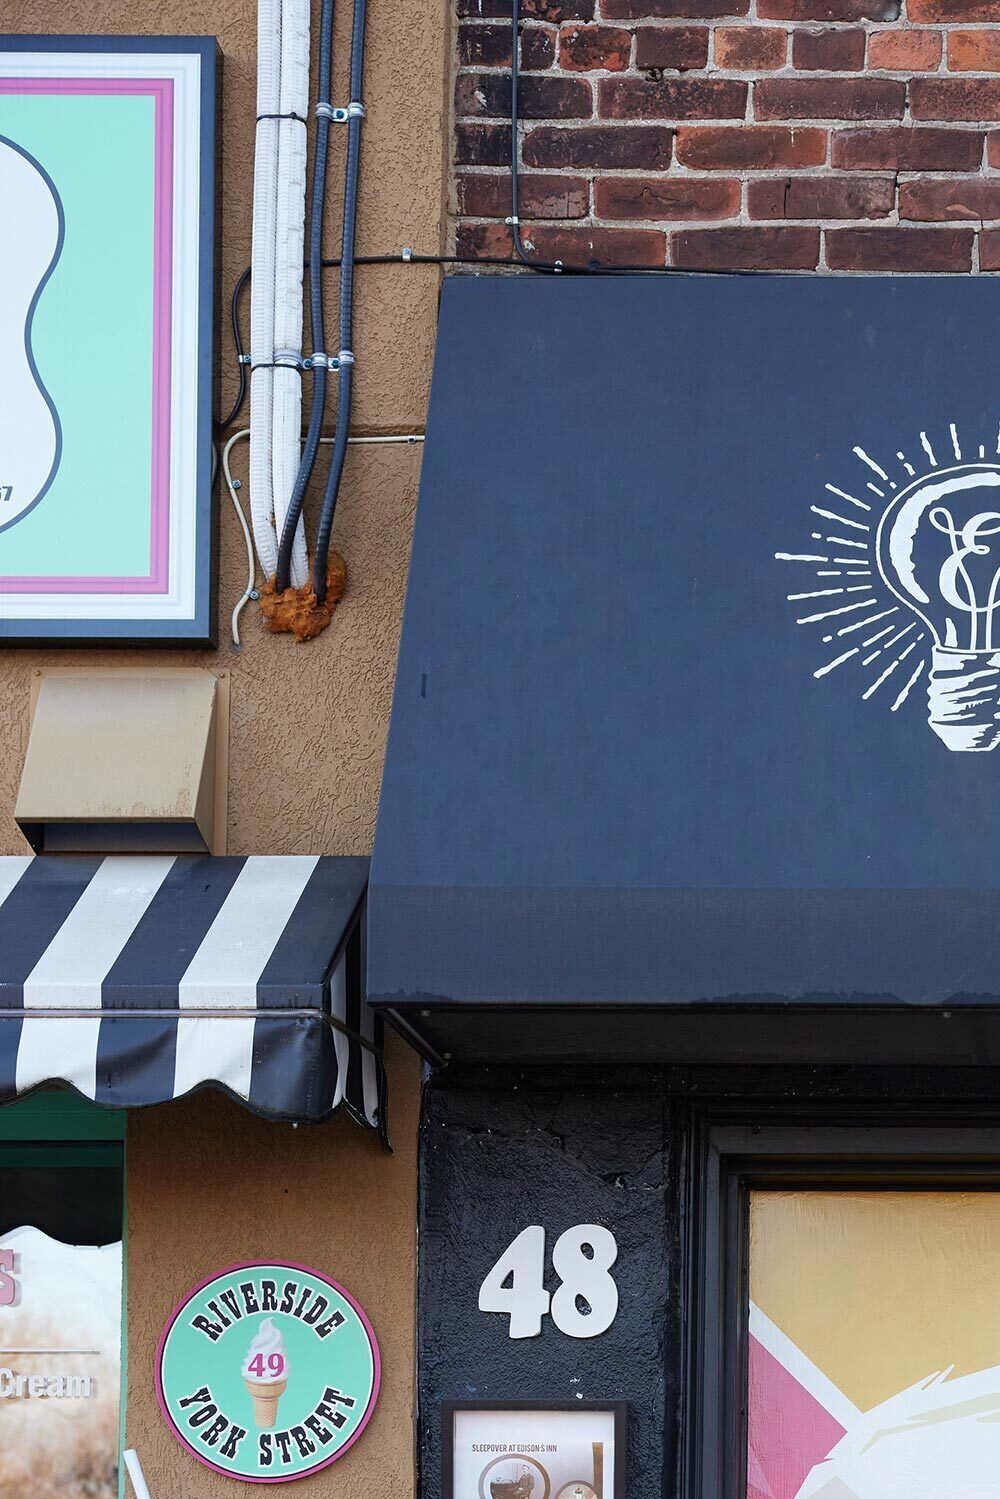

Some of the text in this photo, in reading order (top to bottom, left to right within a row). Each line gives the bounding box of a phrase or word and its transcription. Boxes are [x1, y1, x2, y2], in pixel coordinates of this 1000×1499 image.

[191, 1280, 346, 1341] RIVERSIDE
[478, 1224, 618, 1339] 48
[248, 1353, 284, 1377] 49
[179, 1387, 355, 1466] YORK STREET
[472, 1444, 507, 1452] SLEEPOVER
[509, 1444, 515, 1452] AT
